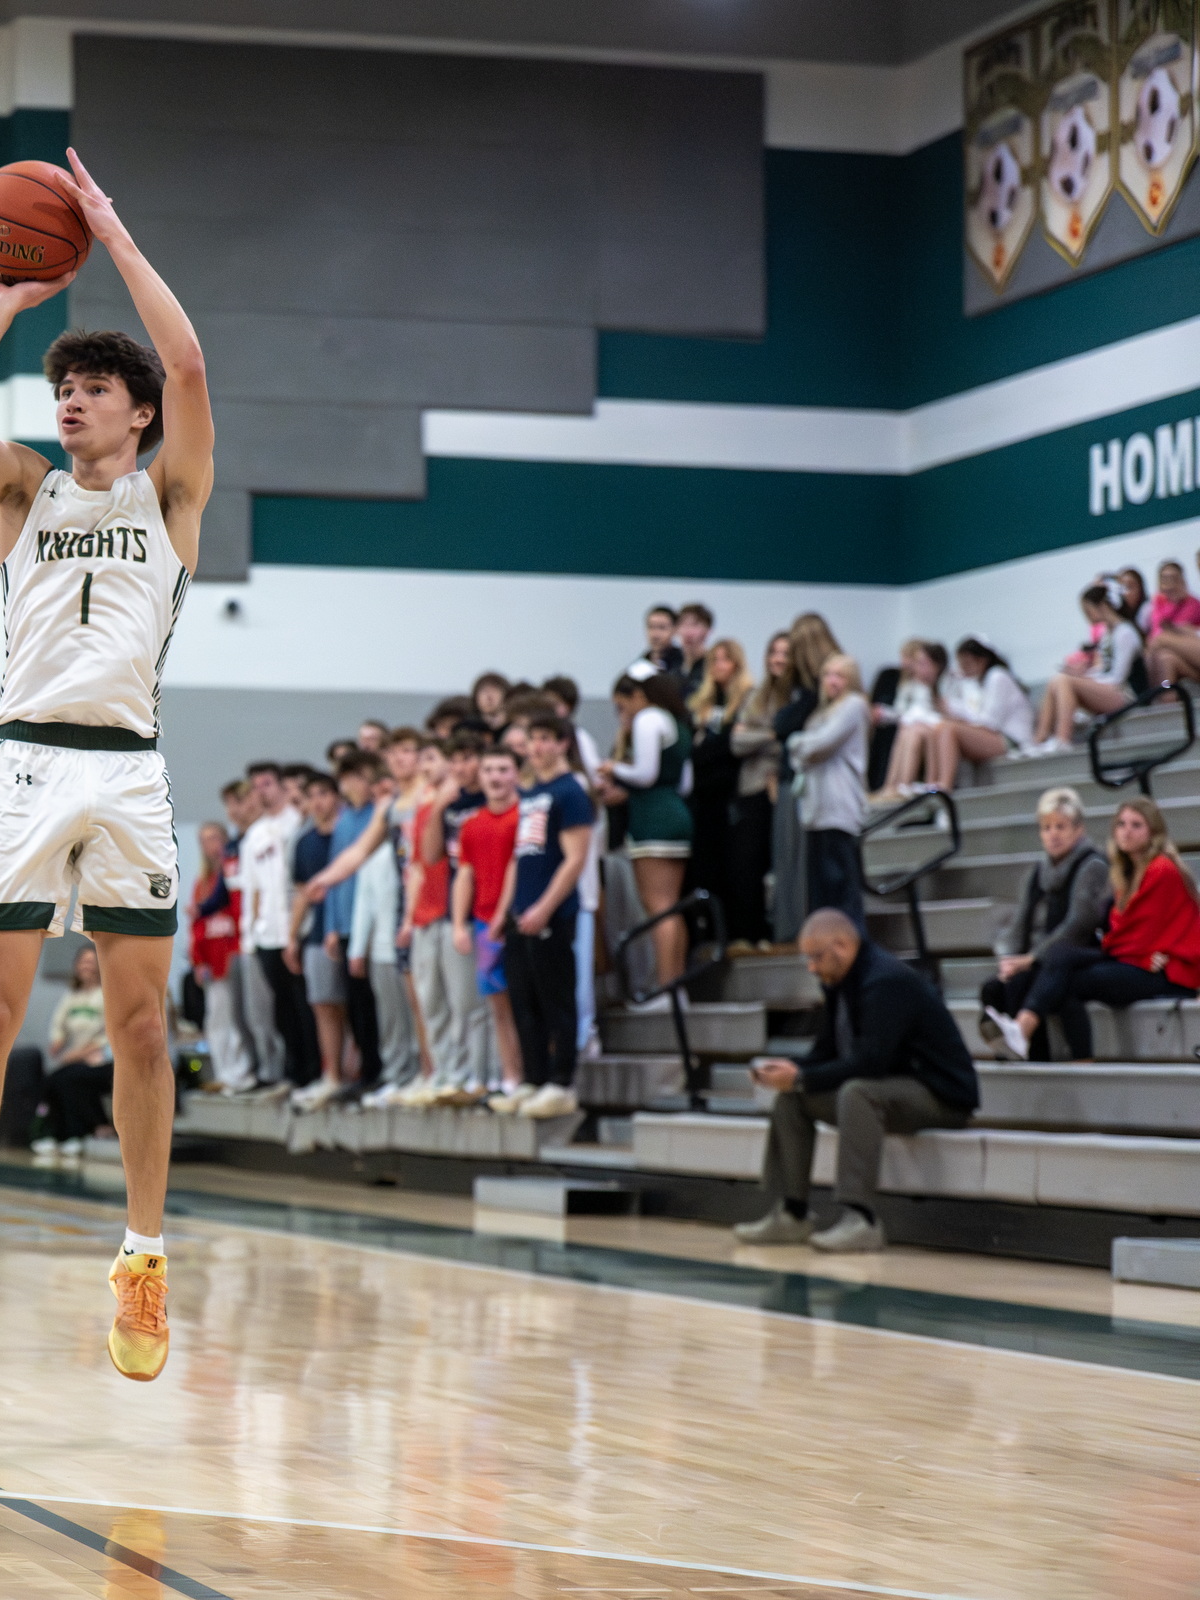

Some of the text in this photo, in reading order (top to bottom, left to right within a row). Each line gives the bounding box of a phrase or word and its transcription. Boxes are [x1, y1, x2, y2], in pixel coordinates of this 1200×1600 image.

[1088, 414, 1200, 517] HOM
[35, 526, 148, 564] KNIGHTS
[79, 572, 94, 625] 1
